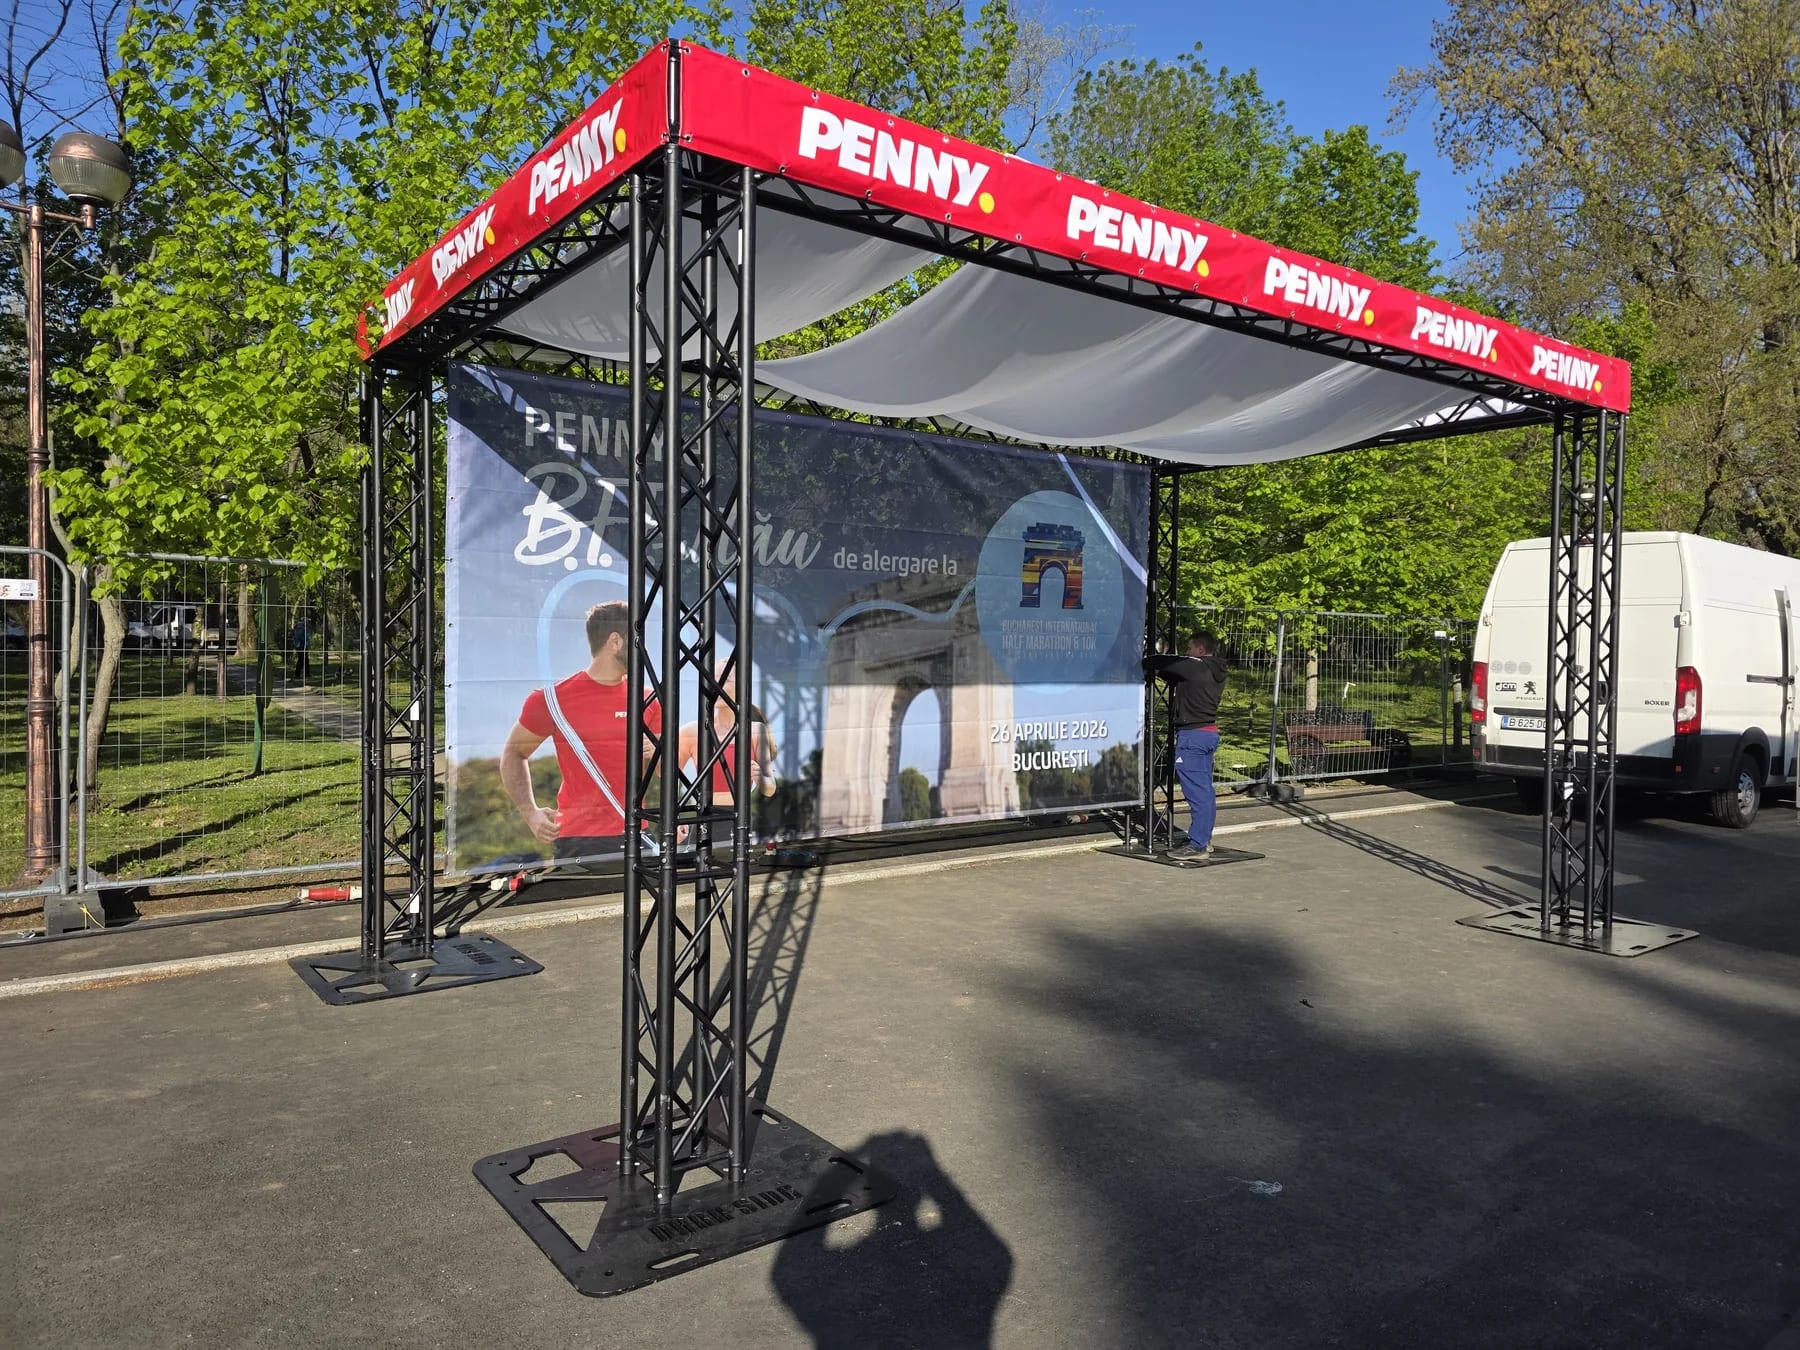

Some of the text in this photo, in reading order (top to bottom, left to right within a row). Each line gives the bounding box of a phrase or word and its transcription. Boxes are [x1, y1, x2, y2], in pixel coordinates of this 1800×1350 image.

[834, 547, 958, 576] de alergare la
[1002, 634, 1024, 649] HALF
[1026, 635, 1071, 650] MARATHON
[991, 719, 1108, 743] 26 APRILIE 2026
[1517, 719, 1535, 728] 625
[1011, 749, 1088, 773] BUCUREȘTI
